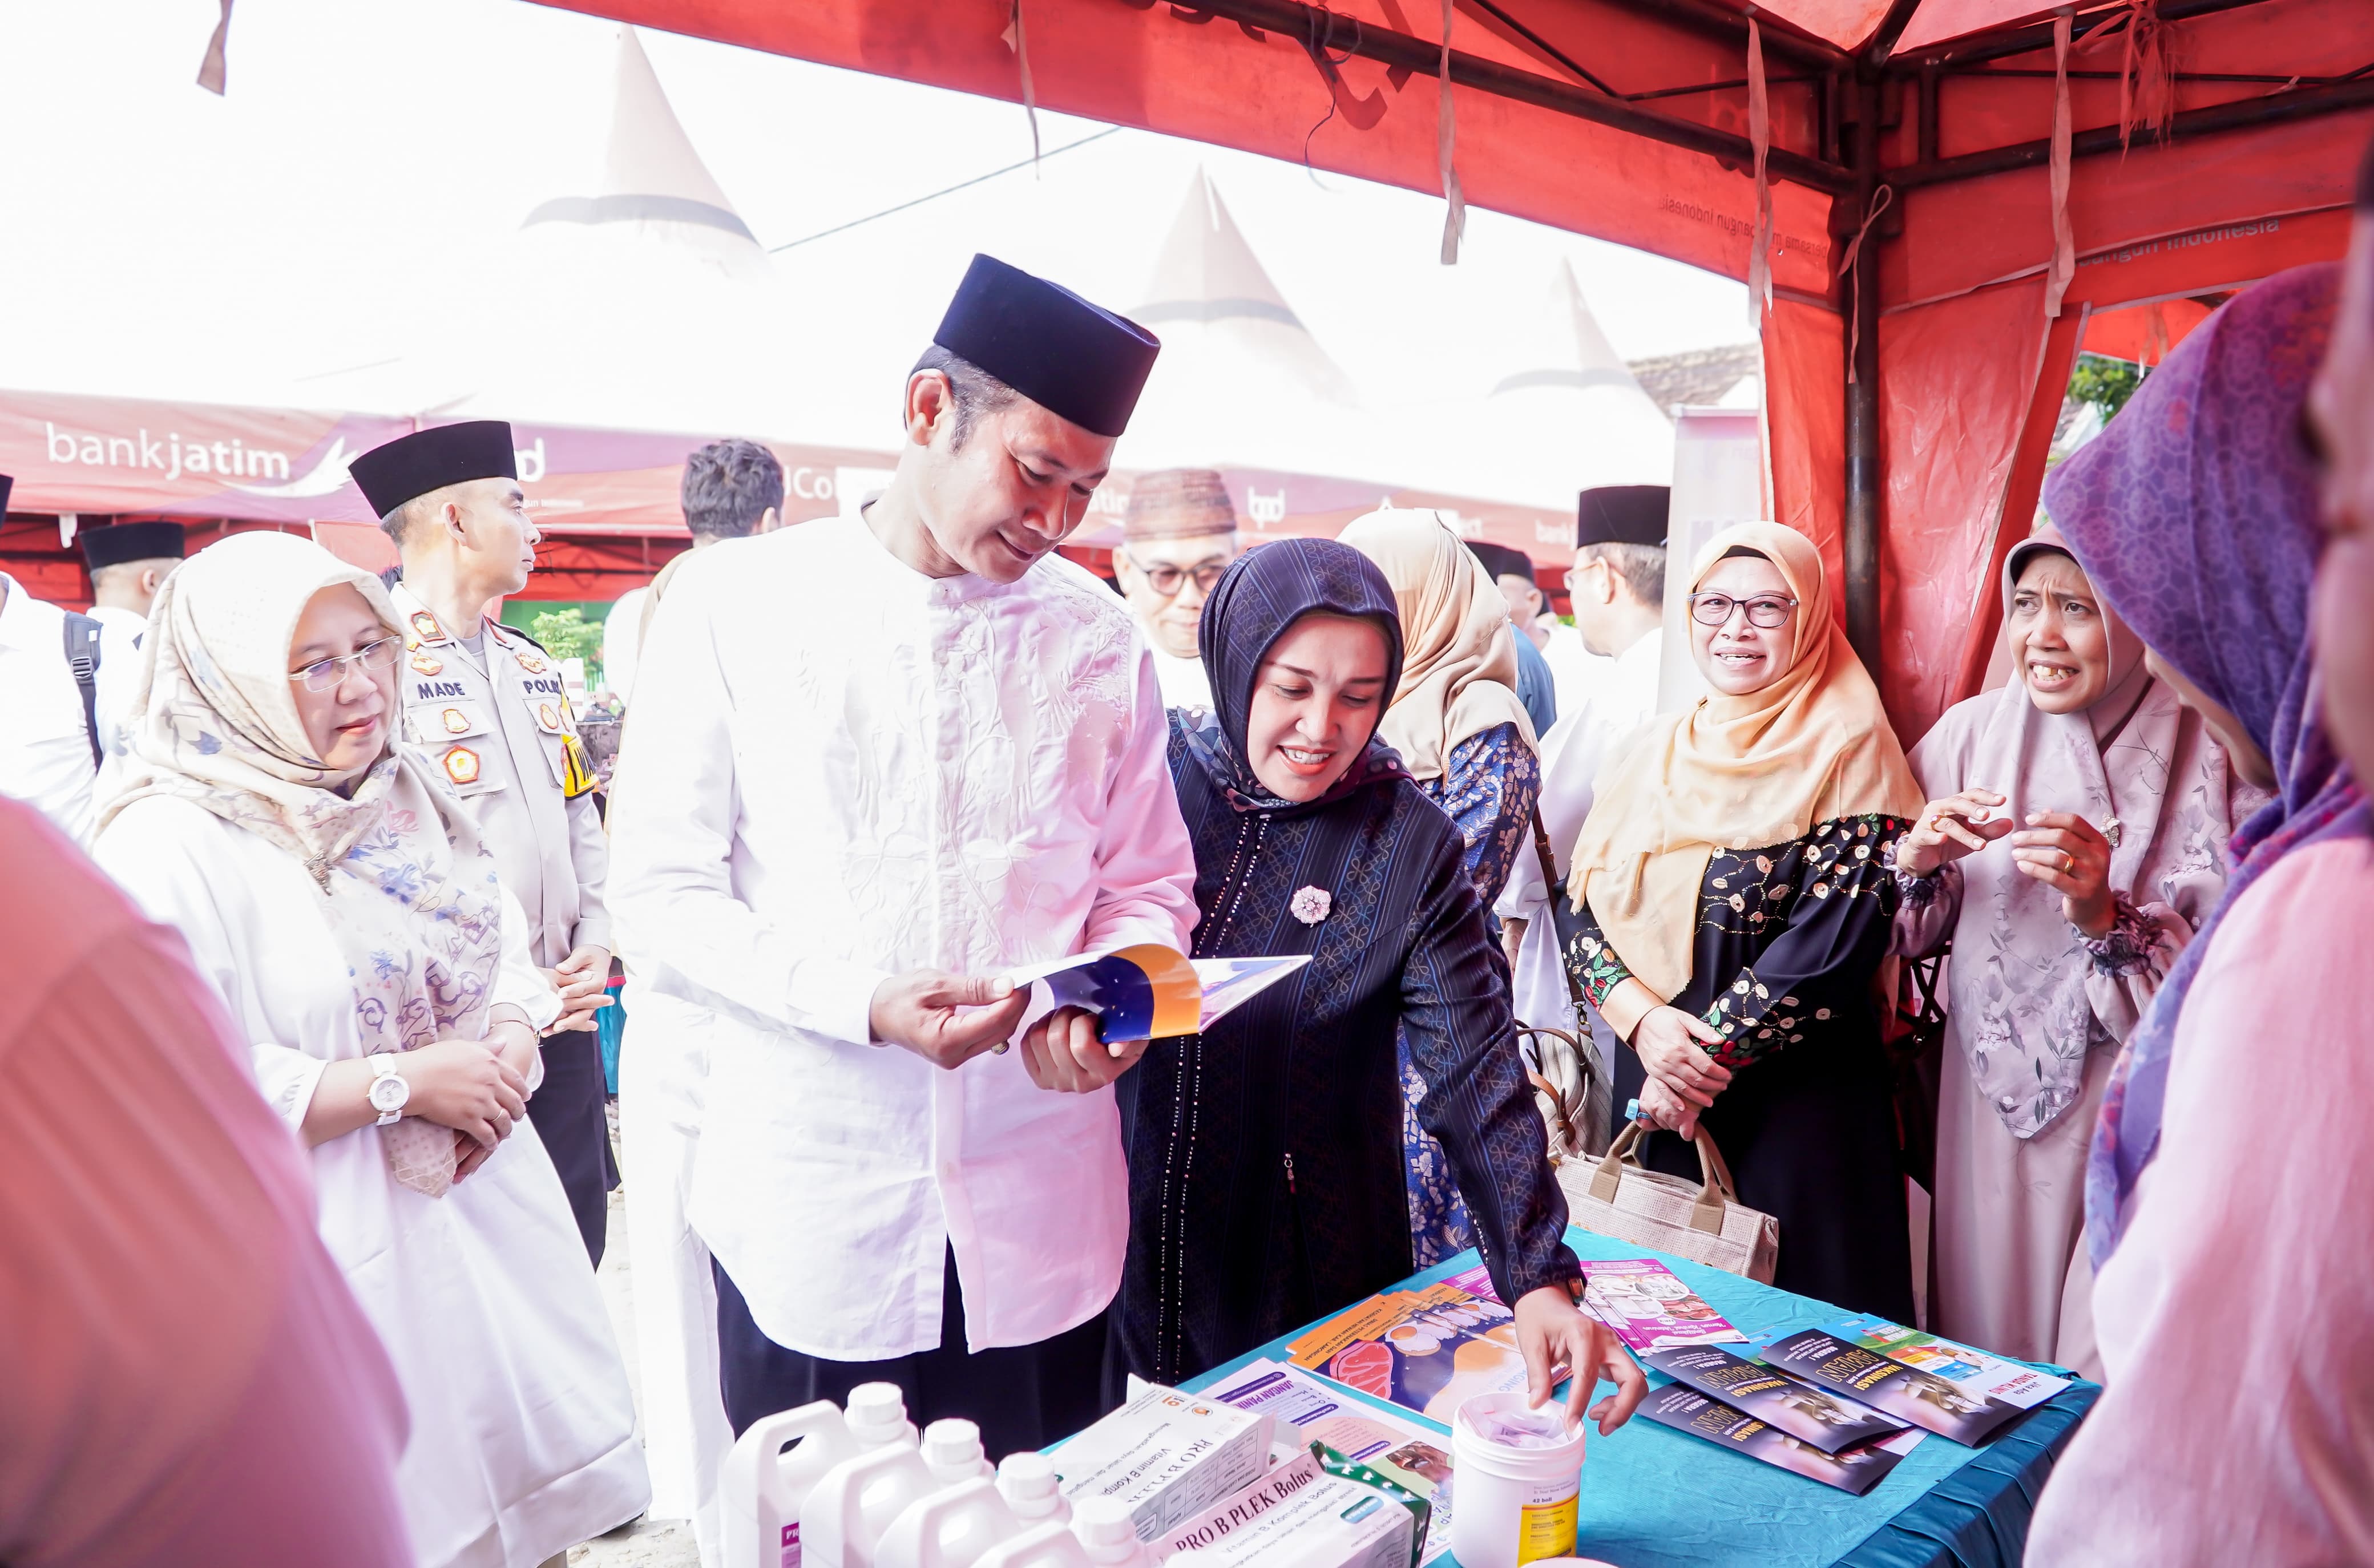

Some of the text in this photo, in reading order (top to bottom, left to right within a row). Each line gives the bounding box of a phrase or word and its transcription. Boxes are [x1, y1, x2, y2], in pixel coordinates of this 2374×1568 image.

[417, 682, 465, 700] MADE
[1696, 1365, 1767, 1389] AMAN
[1816, 1349, 1879, 1383] AMAN
[1854, 1364, 1903, 1391] VAKSINASI
[1260, 1380, 1295, 1400] JANGAN
[1731, 1380, 1789, 1397] VAKSINASI
[1988, 1372, 2038, 1395] TANDA KLINIS
[1690, 1405, 1744, 1434] MAN
[1731, 1420, 1766, 1442] SINASI
[1101, 1448, 1172, 1496] Vitamin B Komp
[1309, 1481, 1338, 1500] Bolus
[1176, 1526, 1215, 1552] PRO
[1213, 1517, 1230, 1536] B
[1228, 1488, 1277, 1527] PLEK
[1273, 1467, 1314, 1500] Bolus
